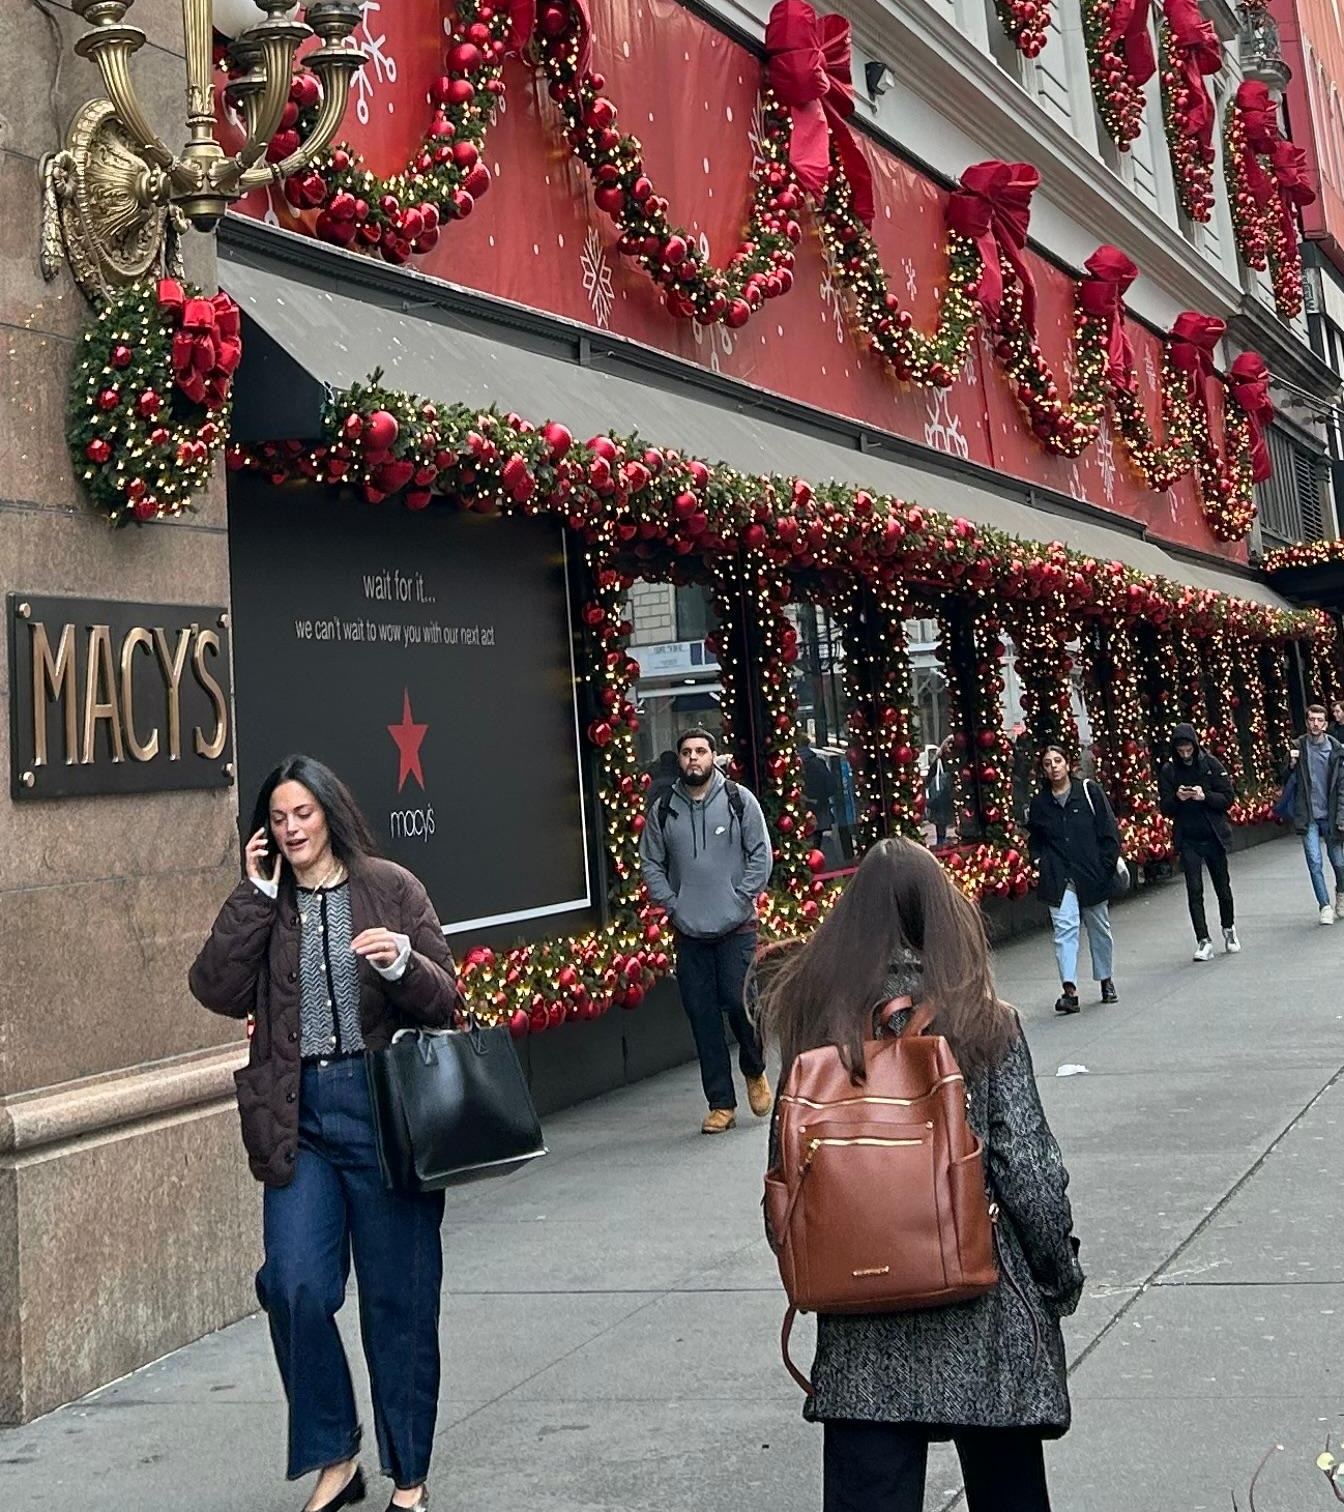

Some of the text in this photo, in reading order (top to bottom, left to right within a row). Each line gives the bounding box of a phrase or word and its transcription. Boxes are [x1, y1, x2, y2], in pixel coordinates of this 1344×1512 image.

[363, 569, 436, 603] wait for it...
[294, 616, 495, 648] we can't wait to wow you with our next act
[30, 621, 227, 766] MACY'S
[390, 802, 435, 843] macy's
